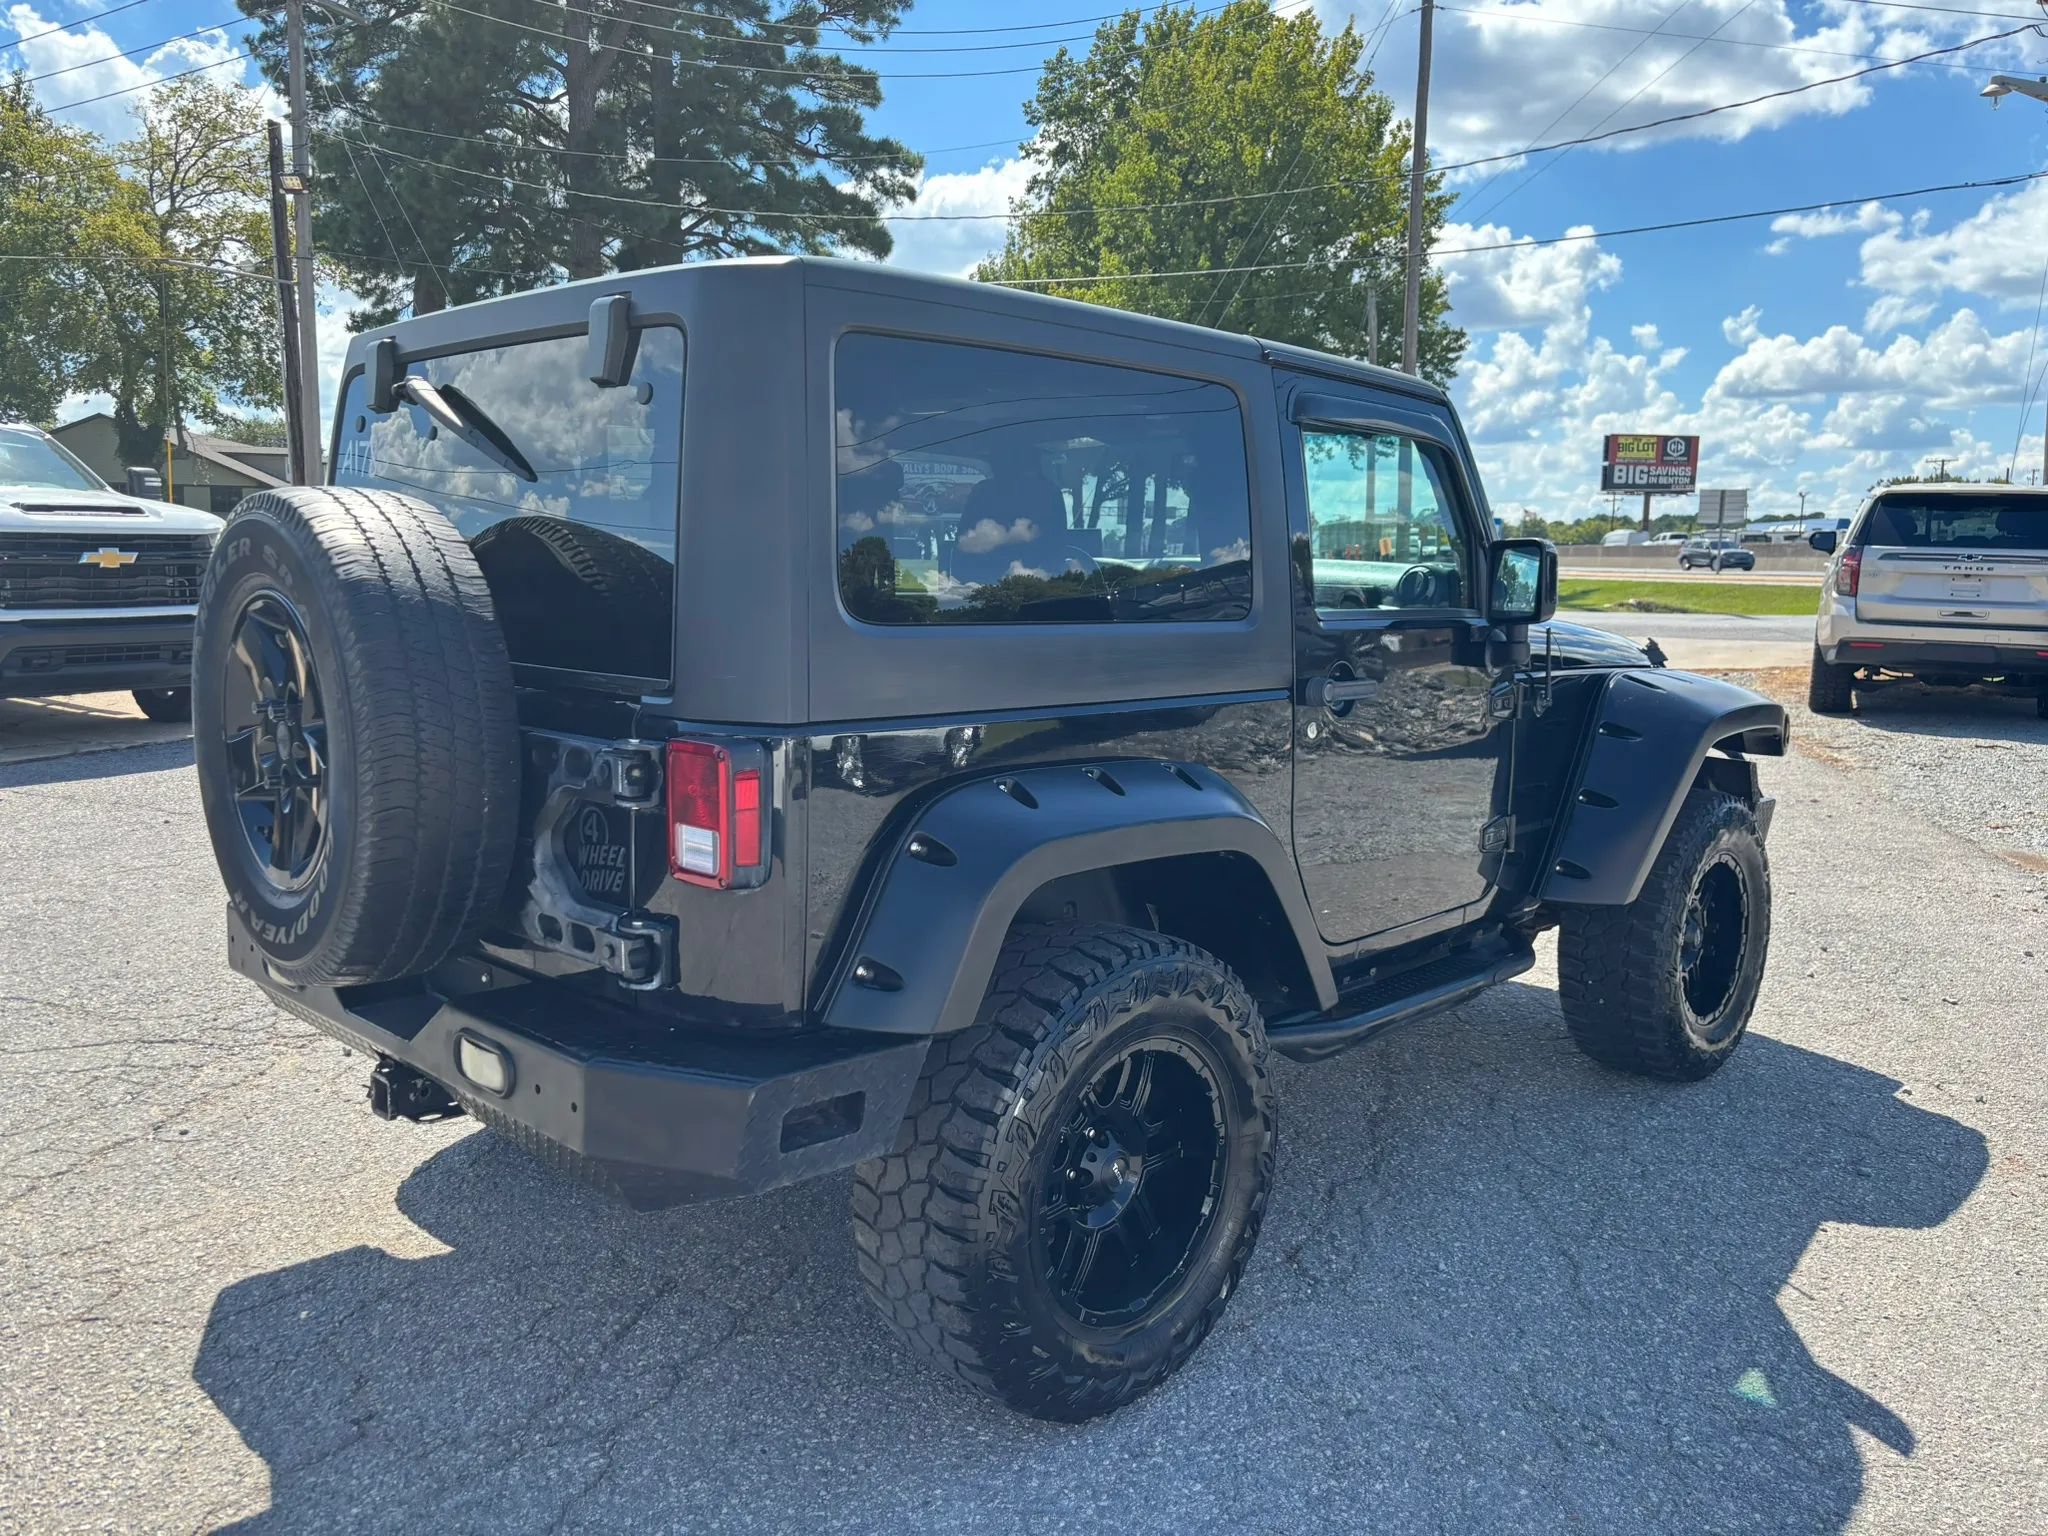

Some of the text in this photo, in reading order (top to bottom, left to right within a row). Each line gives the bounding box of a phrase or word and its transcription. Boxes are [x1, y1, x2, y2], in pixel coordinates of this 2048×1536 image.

[1617, 442, 1657, 453] BIG LOT
[1613, 464, 1692, 485] BIG SAVINGS
[1648, 476, 1690, 484] IN BENTON
[584, 812, 599, 843] 4
[579, 844, 626, 868] WHEEL
[581, 868, 625, 892] DRIVE
